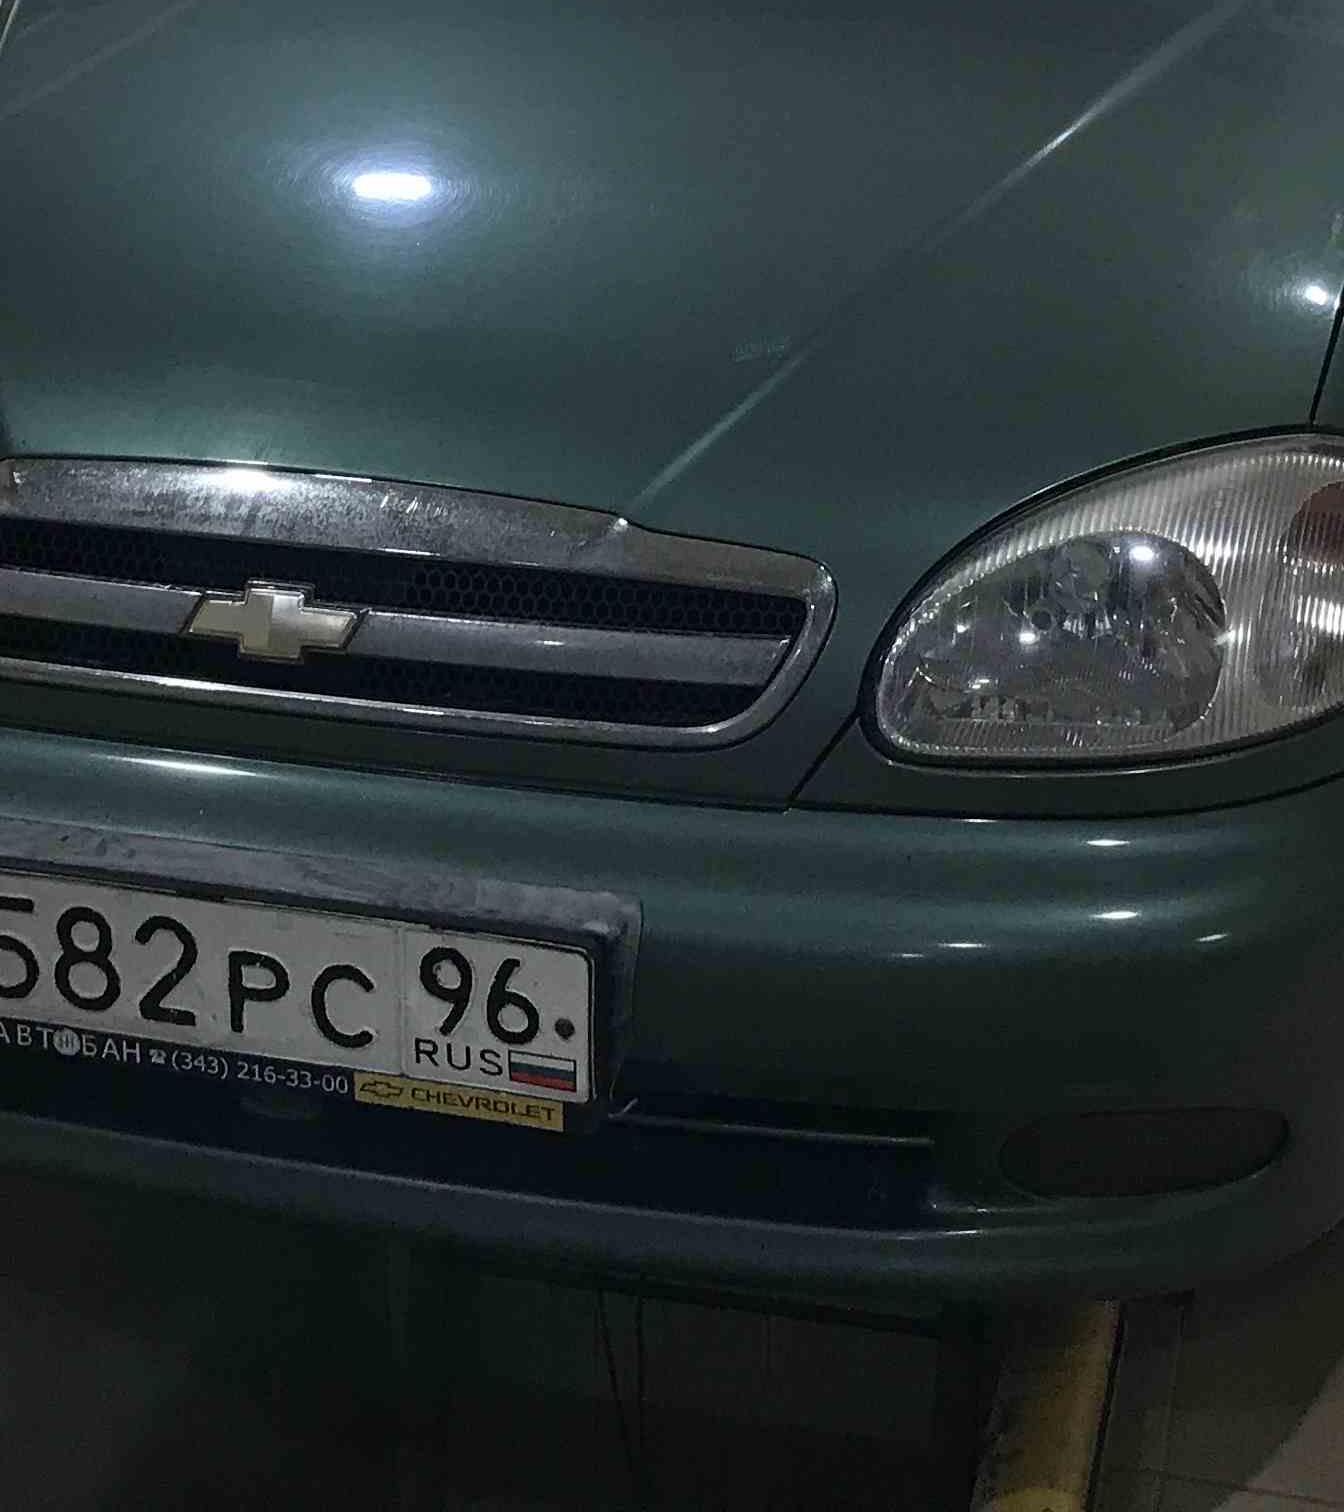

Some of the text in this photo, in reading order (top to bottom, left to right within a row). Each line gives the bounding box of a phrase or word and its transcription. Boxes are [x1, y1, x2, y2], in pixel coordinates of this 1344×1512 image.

[420, 946, 540, 1046] 96
[171, 1048, 229, 1080] (343)
[237, 1061, 349, 1095] 216-33-00
[414, 1037, 504, 1077] RUS
[410, 1086, 556, 1122] CHEVROLET
